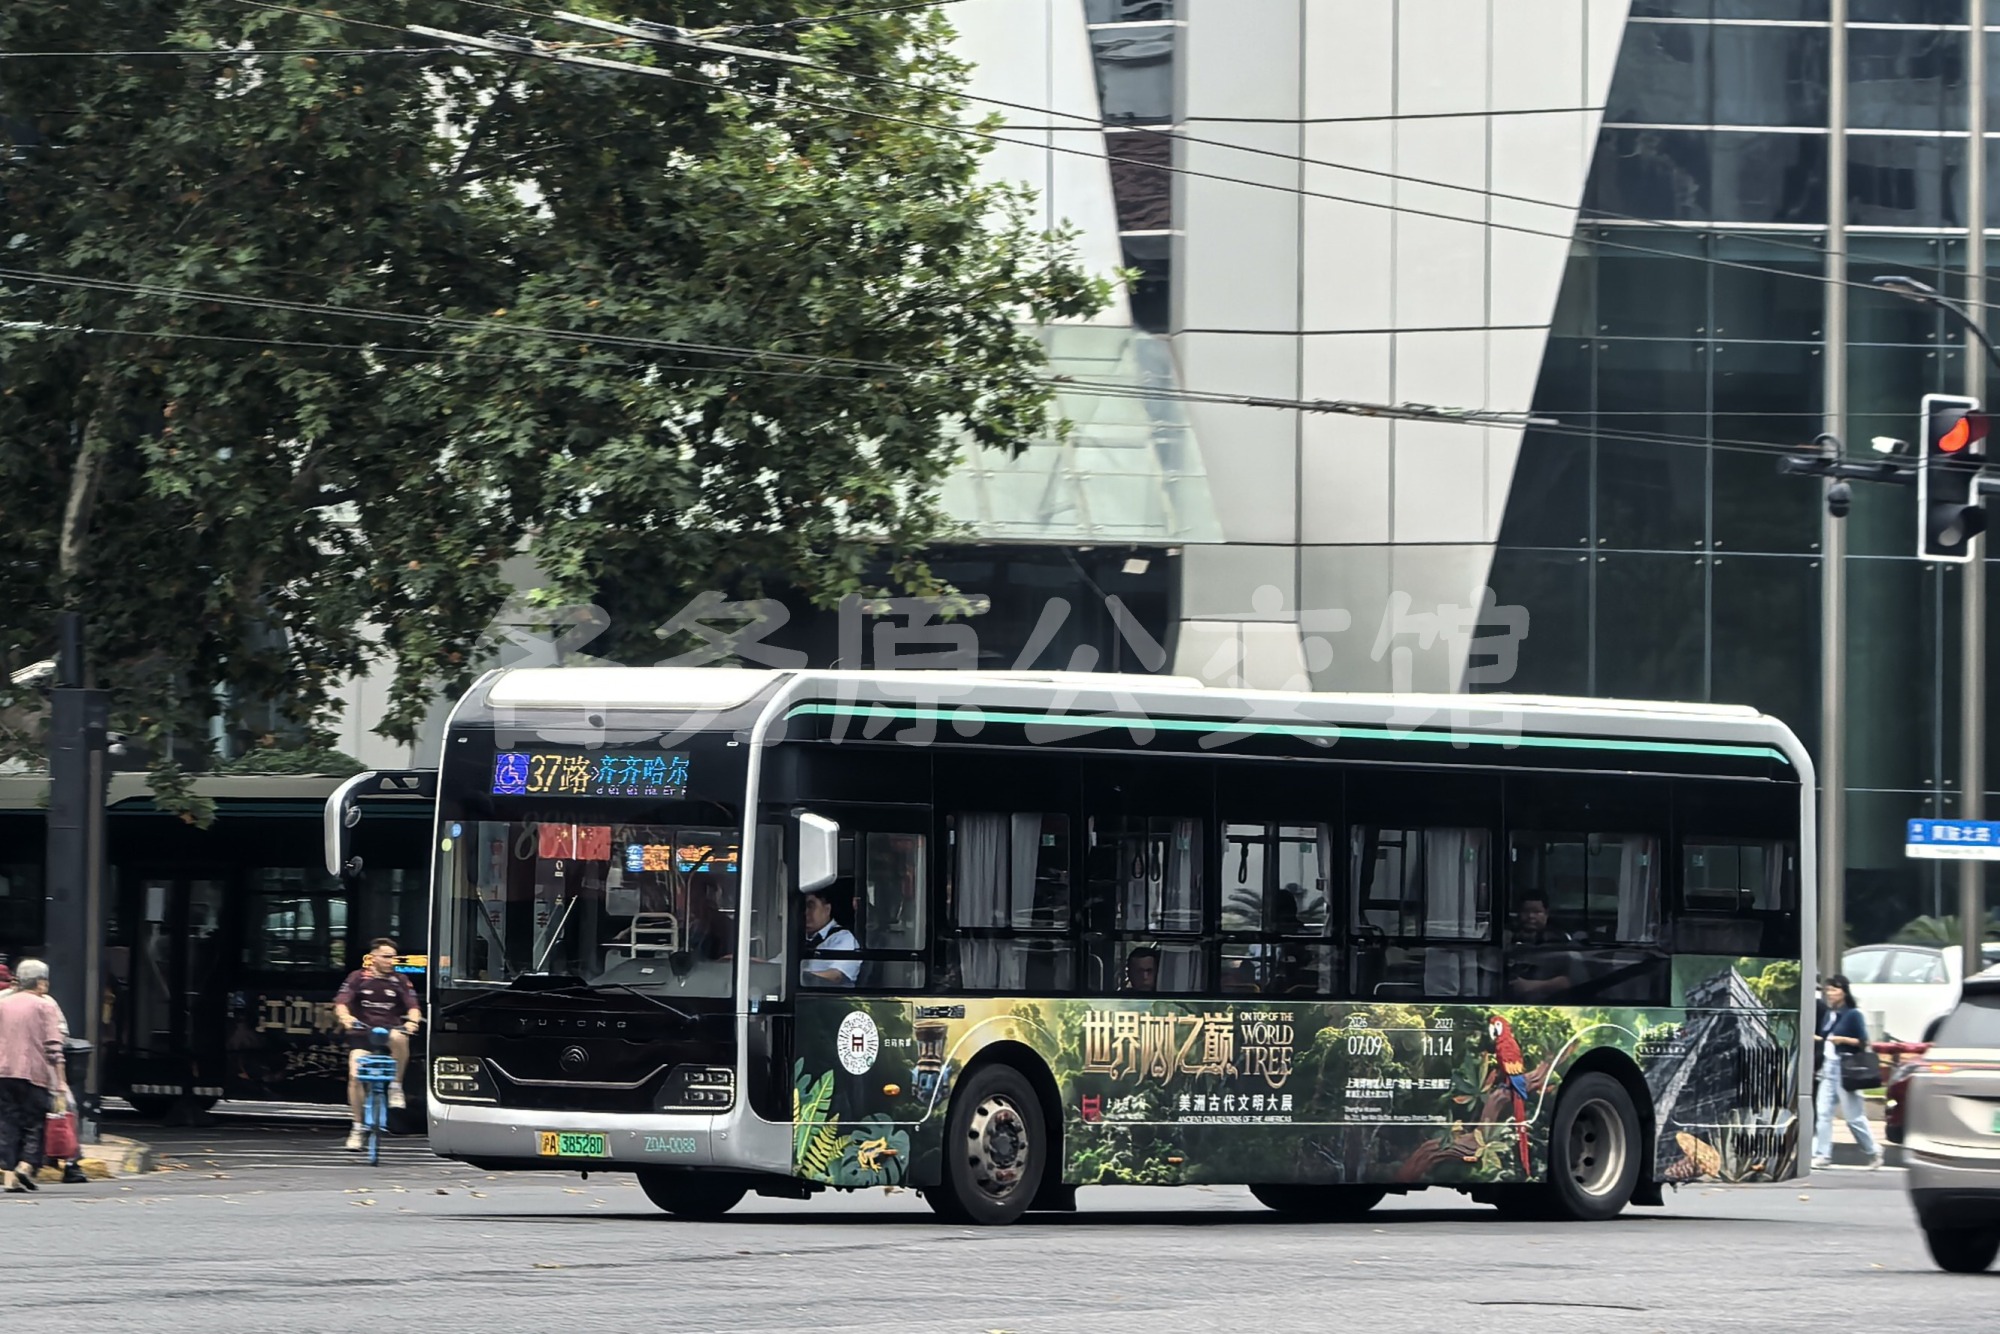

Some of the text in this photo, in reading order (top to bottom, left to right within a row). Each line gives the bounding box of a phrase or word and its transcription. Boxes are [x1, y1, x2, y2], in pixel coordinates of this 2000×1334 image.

[526, 754, 592, 795] 37路
[519, 1018, 627, 1028] YUTONG
[1241, 1022, 1294, 1046] WORLD
[1081, 1010, 1238, 1087] 世界树之巅
[1348, 1035, 1454, 1056] 07.09 11.14
[1240, 1046, 1294, 1089] TREE
[1178, 1093, 1294, 1112] 美洲古代文明大展
[562, 1135, 603, 1154] 38528D
